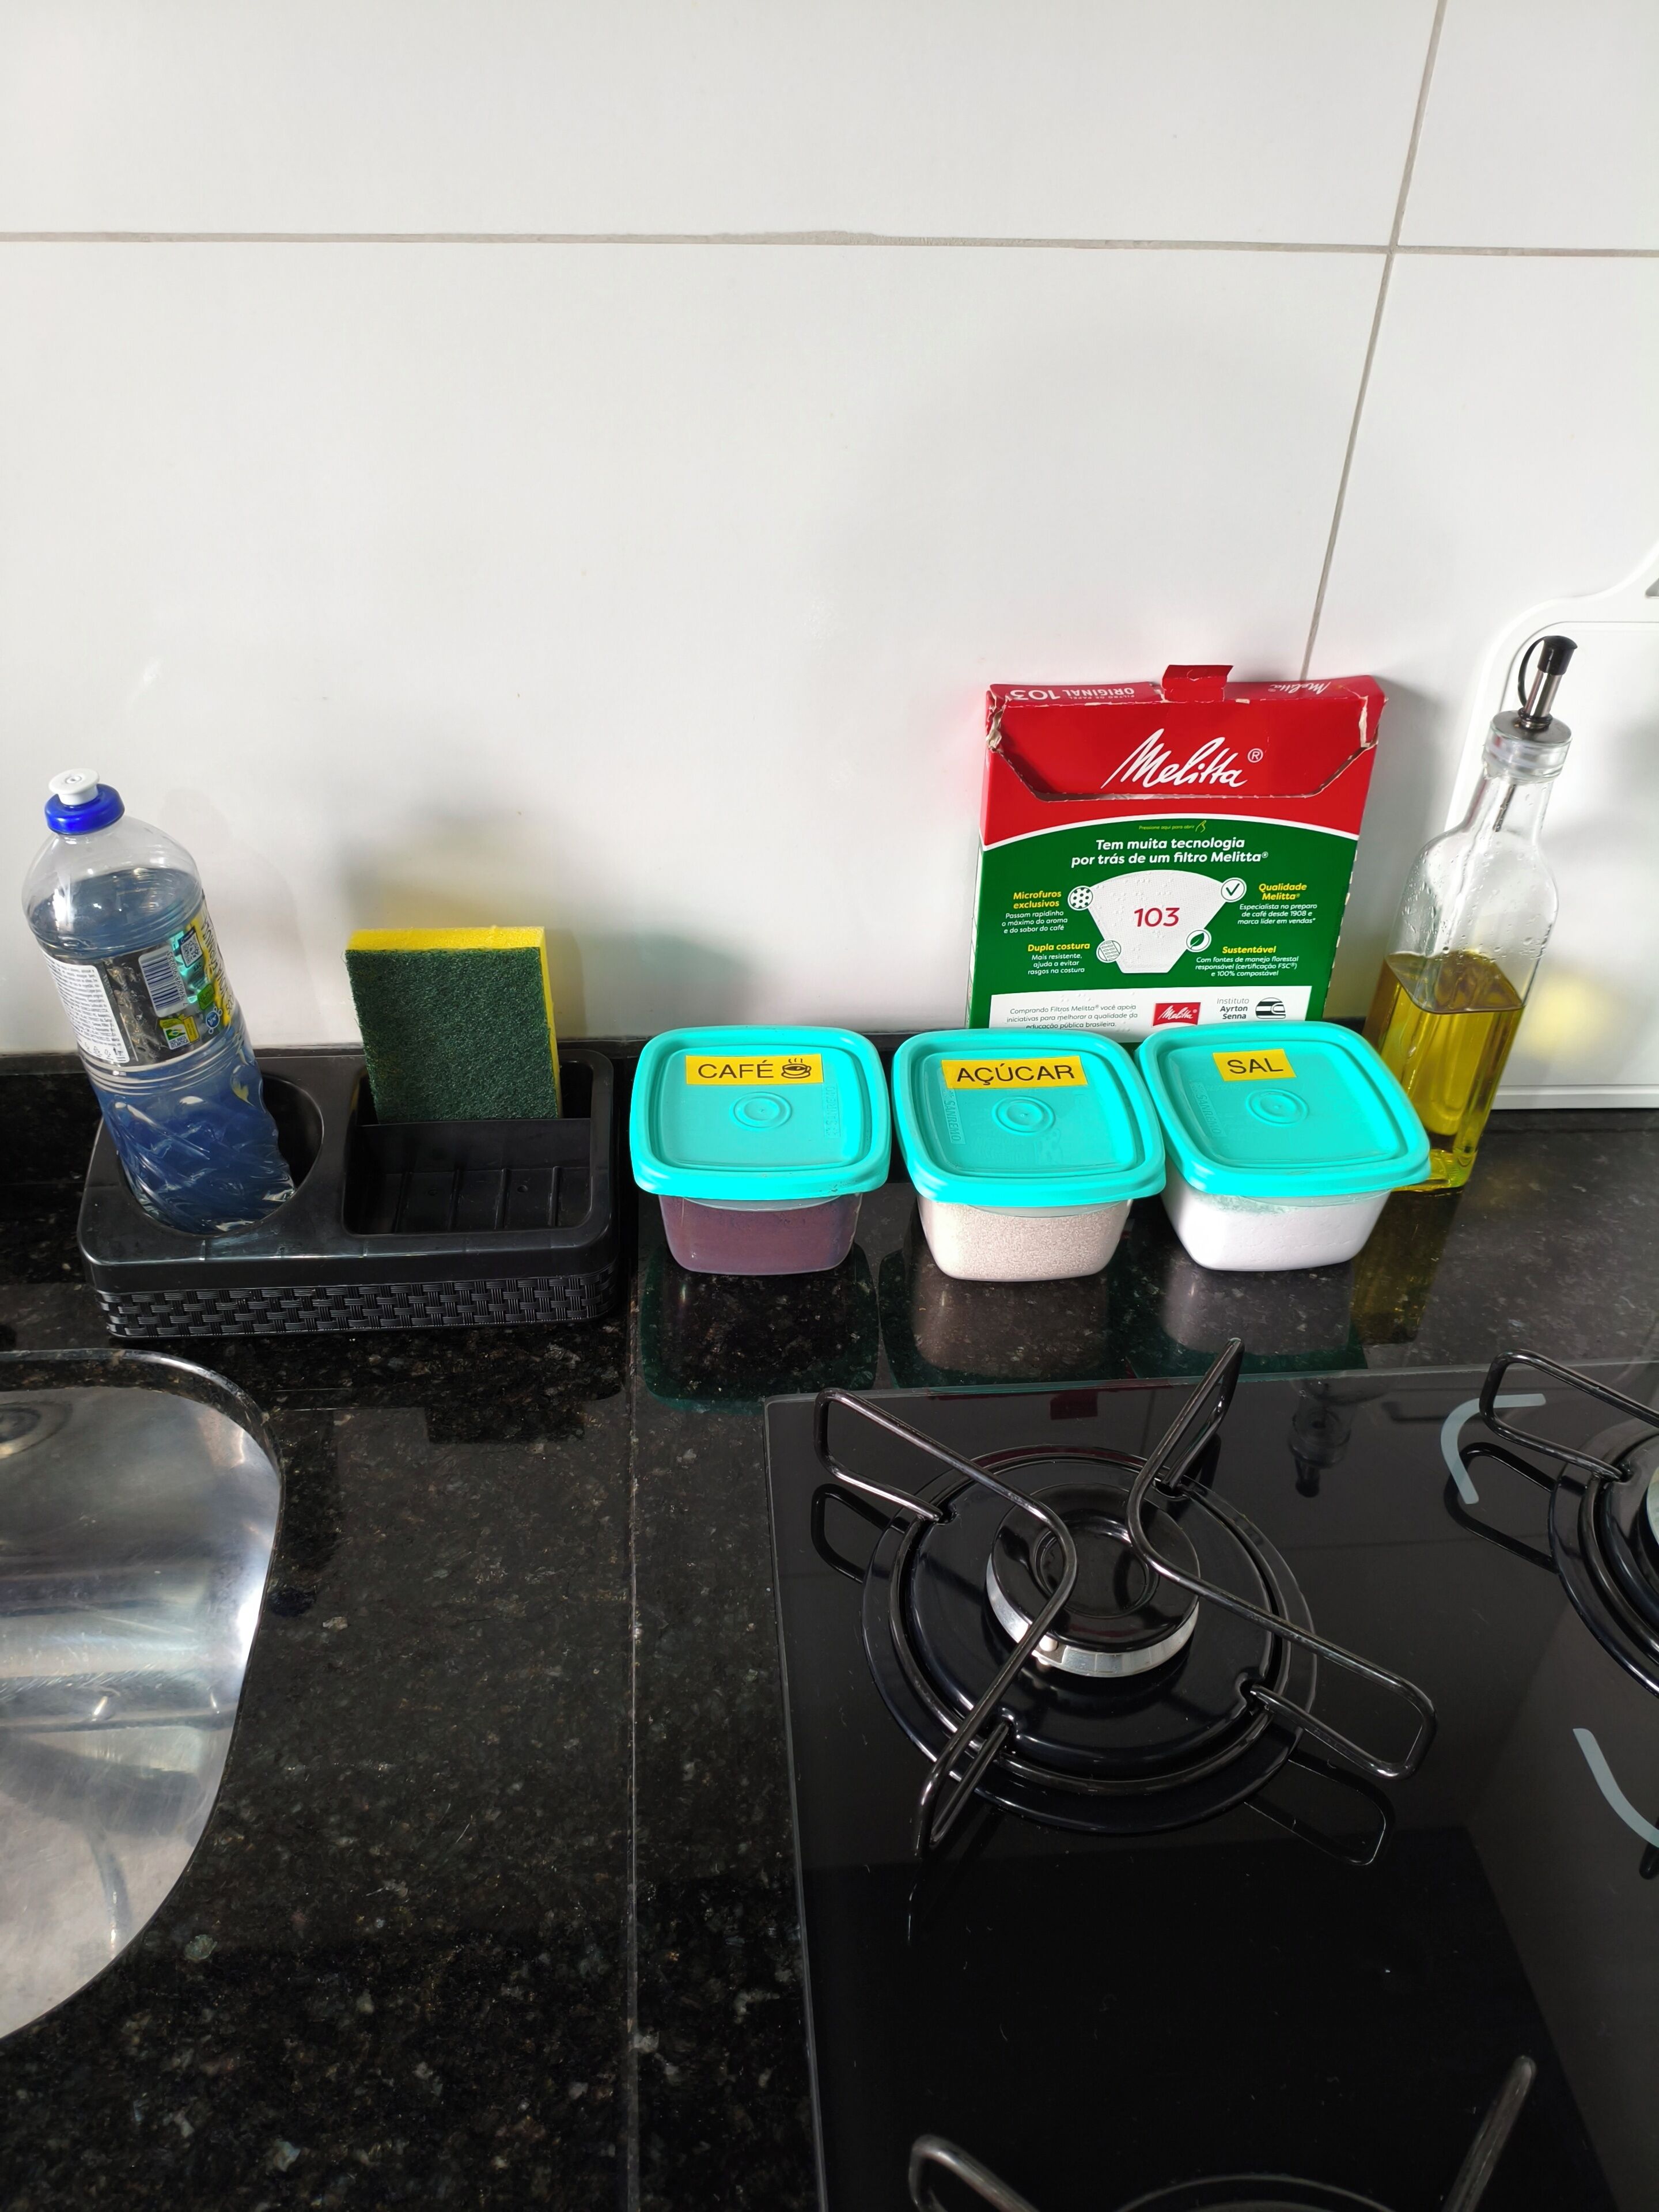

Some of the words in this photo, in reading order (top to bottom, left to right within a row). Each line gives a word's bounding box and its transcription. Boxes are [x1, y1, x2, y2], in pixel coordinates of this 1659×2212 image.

[1010, 690, 1060, 700] 103
[1062, 688, 1134, 696] ORIGINAL
[1096, 839, 1123, 850] Tem
[1127, 838, 1168, 849] muita
[1171, 837, 1245, 850] tecnologia
[1071, 857, 1095, 868] por
[1098, 854, 1124, 864] trás
[1128, 853, 1146, 863] de
[1149, 854, 1170, 863] um
[1173, 852, 1207, 862] filtro
[1259, 883, 1307, 892] Qualidade
[1013, 891, 1062, 899] Microfuros
[1013, 900, 1059, 908] exclusivos
[1134, 907, 1180, 927] 103
[1028, 944, 1054, 953] Dupla
[698, 1060, 774, 1079] CAFÉ
[1227, 1058, 1284, 1074] SAL
[956, 1063, 1075, 1086] AÇÚCAR
[944, 1100, 961, 1142] SANREMO
